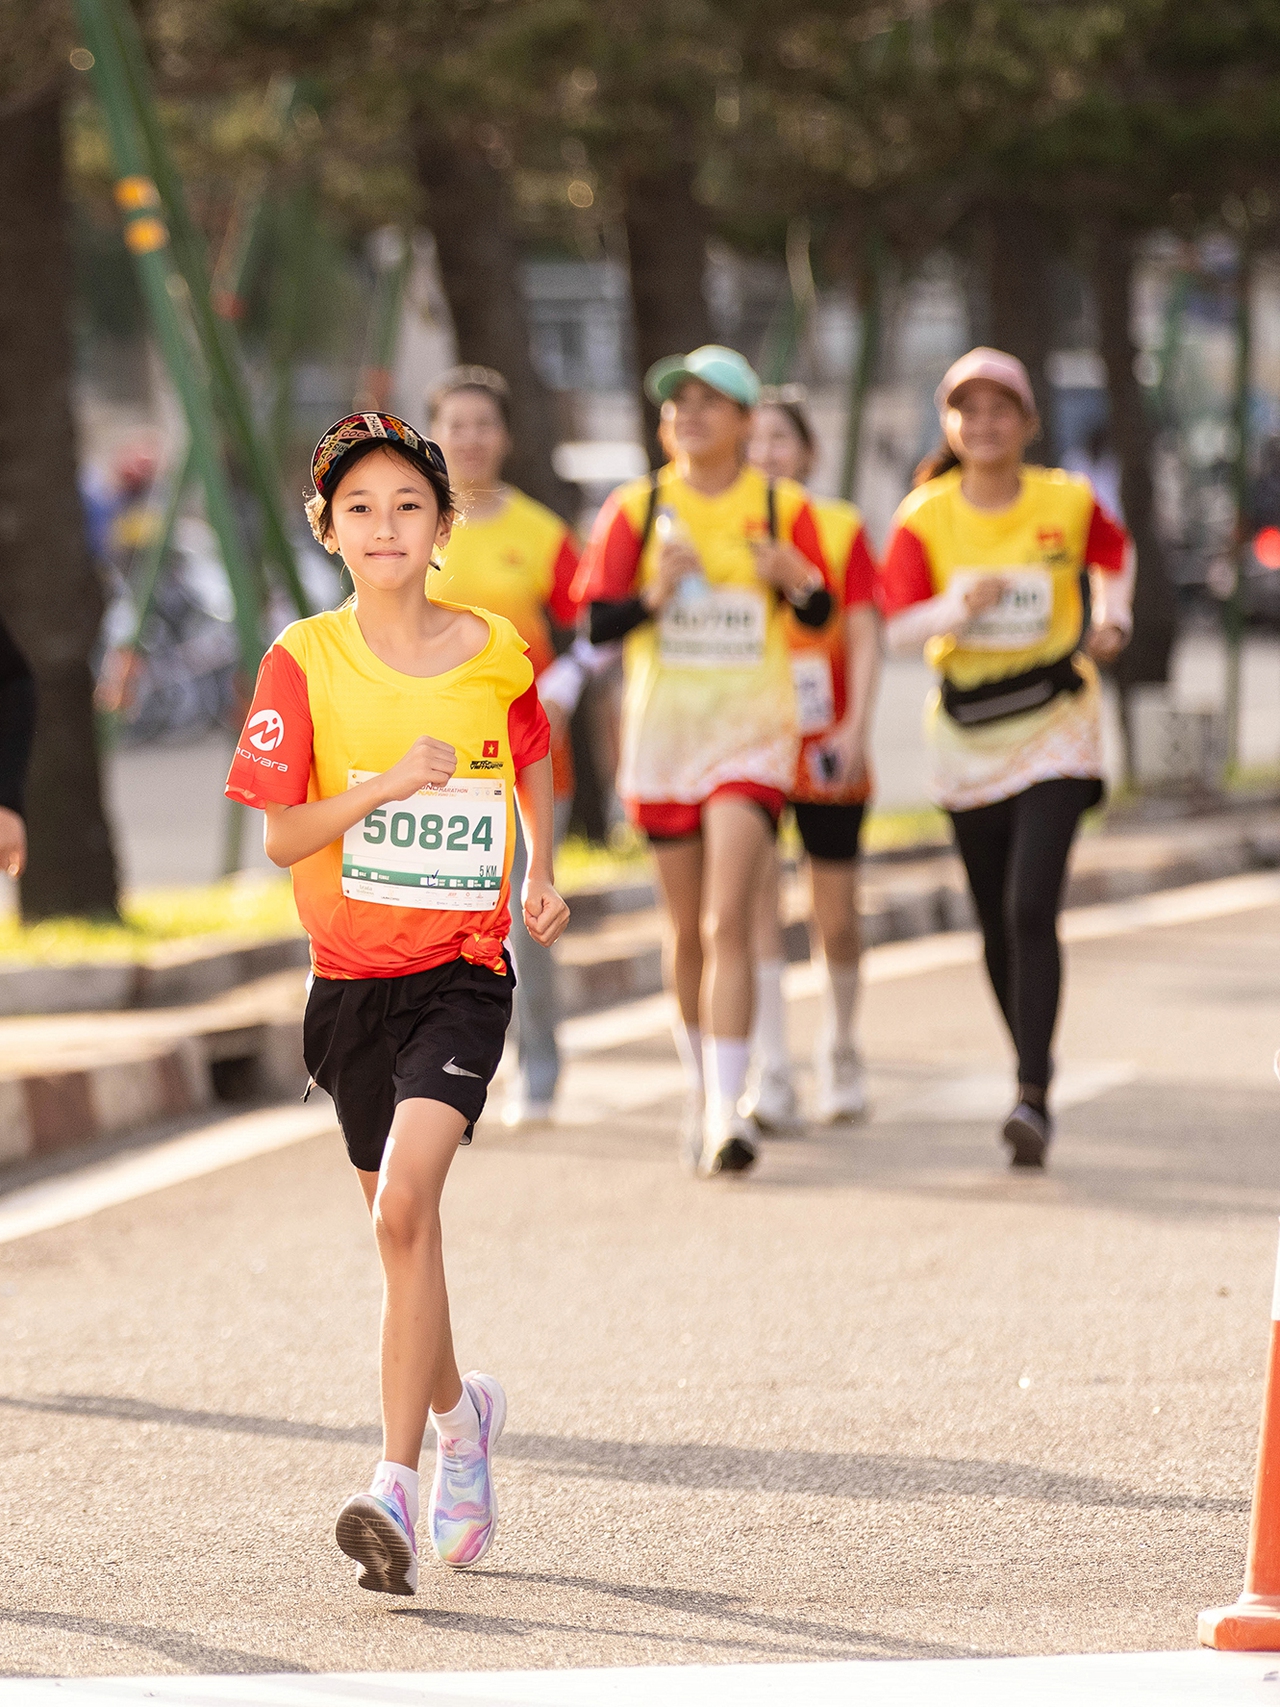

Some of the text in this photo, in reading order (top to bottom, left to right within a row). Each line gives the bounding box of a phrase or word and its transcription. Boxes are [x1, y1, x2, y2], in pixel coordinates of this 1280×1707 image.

[366, 415, 385, 438] CHANE
[363, 809, 493, 852] 50824
[479, 865, 498, 878] 5 KM
